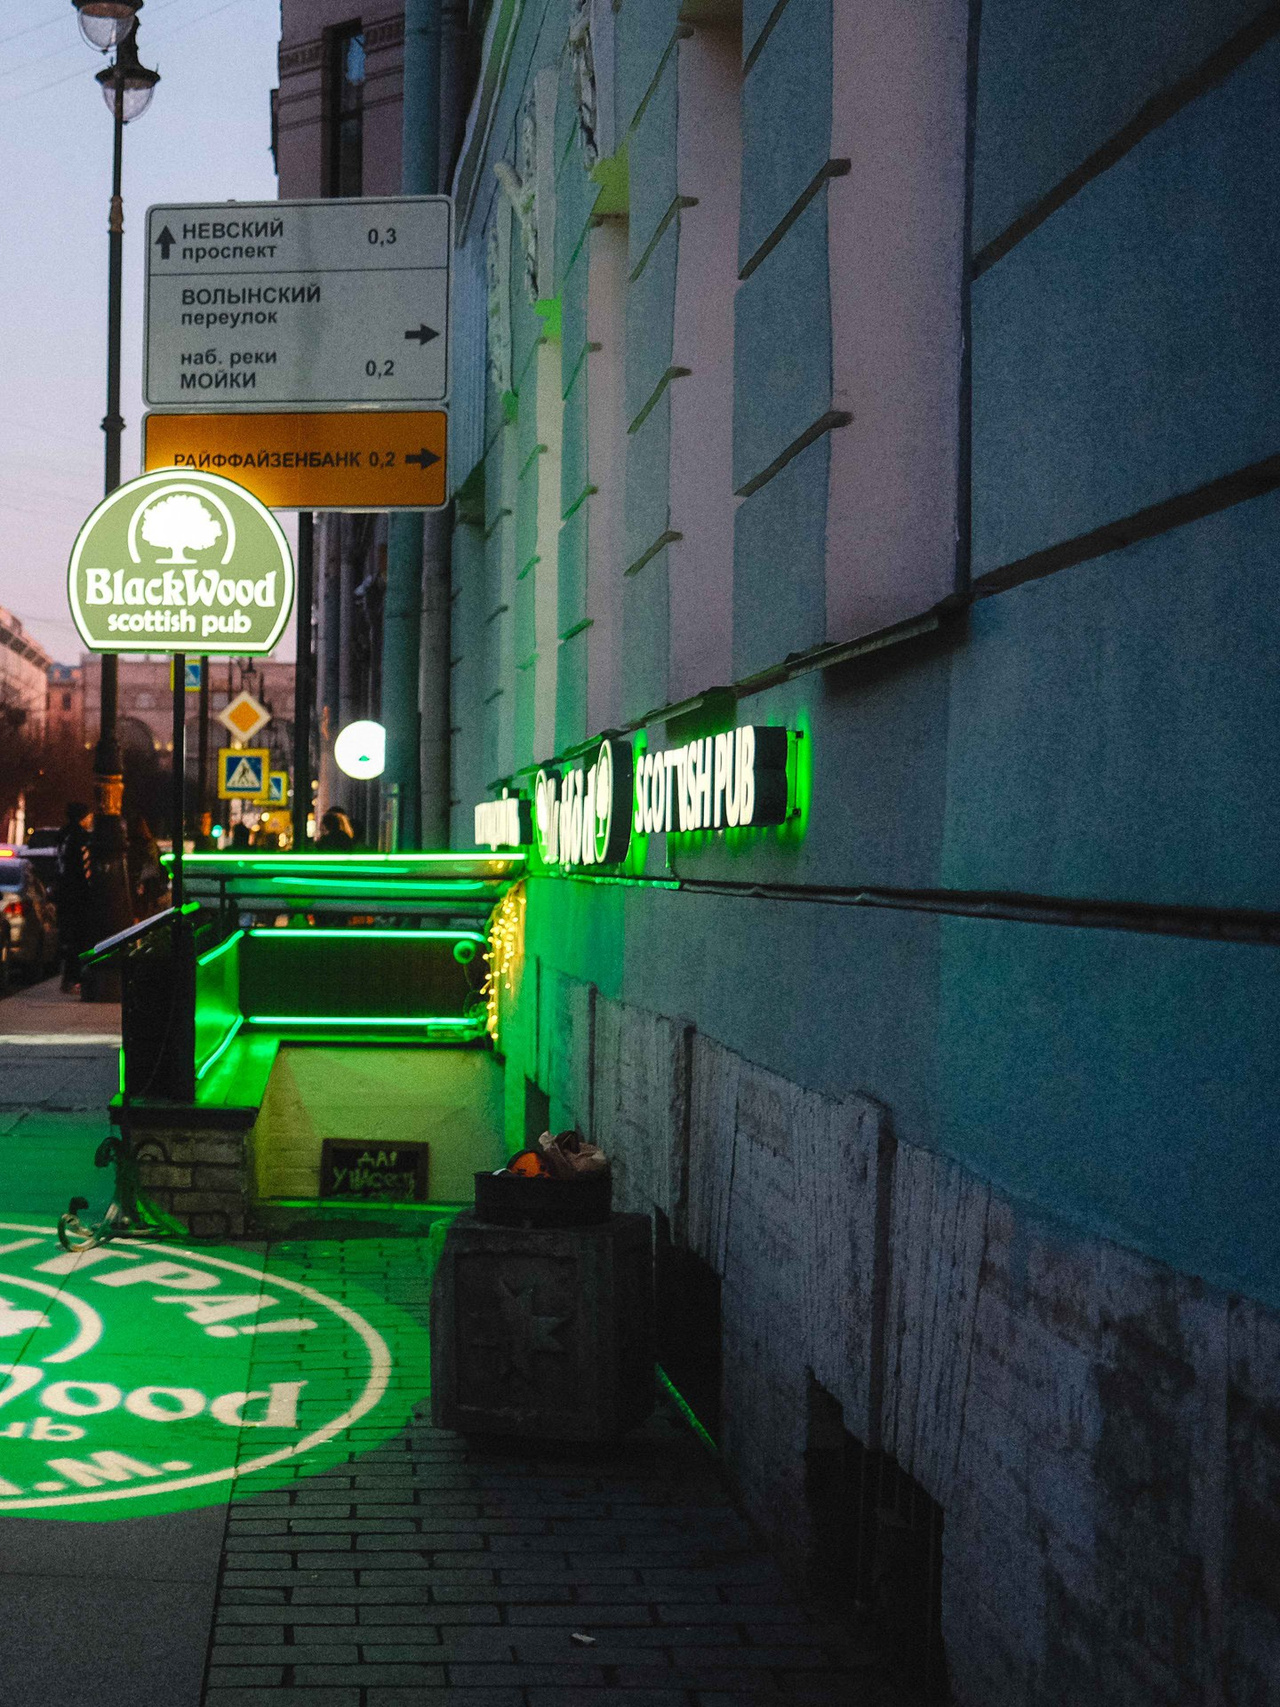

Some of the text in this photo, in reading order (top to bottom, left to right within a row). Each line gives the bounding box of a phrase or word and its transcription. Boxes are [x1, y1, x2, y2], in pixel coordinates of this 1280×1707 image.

[182, 218, 397, 247] НЕВСКИЙ 0,3
[182, 244, 277, 263] проспект
[181, 283, 322, 305] ВОЛЫНСКИЙ
[181, 311, 277, 329] переулок
[181, 348, 395, 378] наб. реки 0,2
[181, 368, 257, 389] МОЙКИ
[174, 450, 396, 468] РАЙФФАЙЗЕНБАНК 0,2
[85, 568, 277, 607] BlackWood
[107, 609, 252, 637] scottish pub
[634, 736, 713, 833] SCOTTISH
[714, 725, 755, 827] PUB
